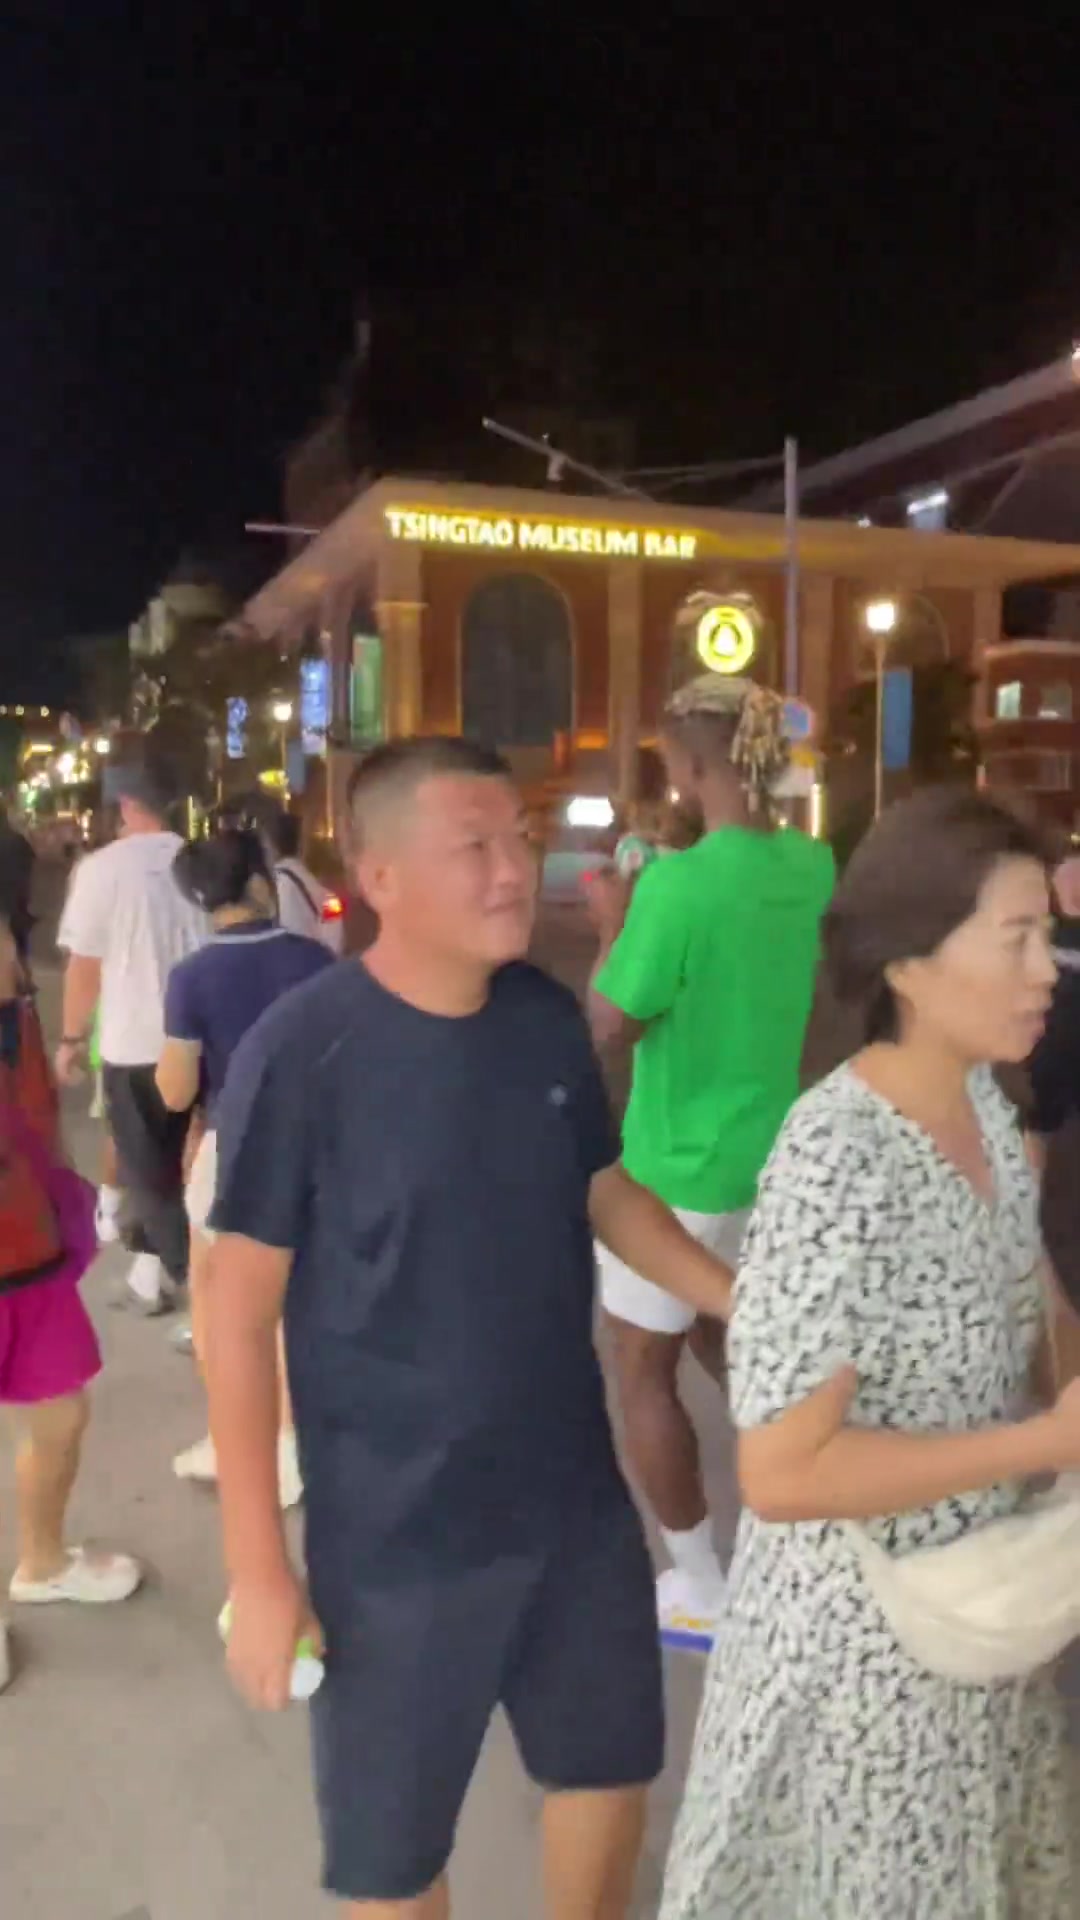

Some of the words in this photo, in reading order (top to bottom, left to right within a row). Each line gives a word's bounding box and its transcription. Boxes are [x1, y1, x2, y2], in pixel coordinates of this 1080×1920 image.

[385, 509, 515, 546] TSINGTAO
[518, 522, 639, 556] MUSEUM
[644, 531, 697, 559] BAR
